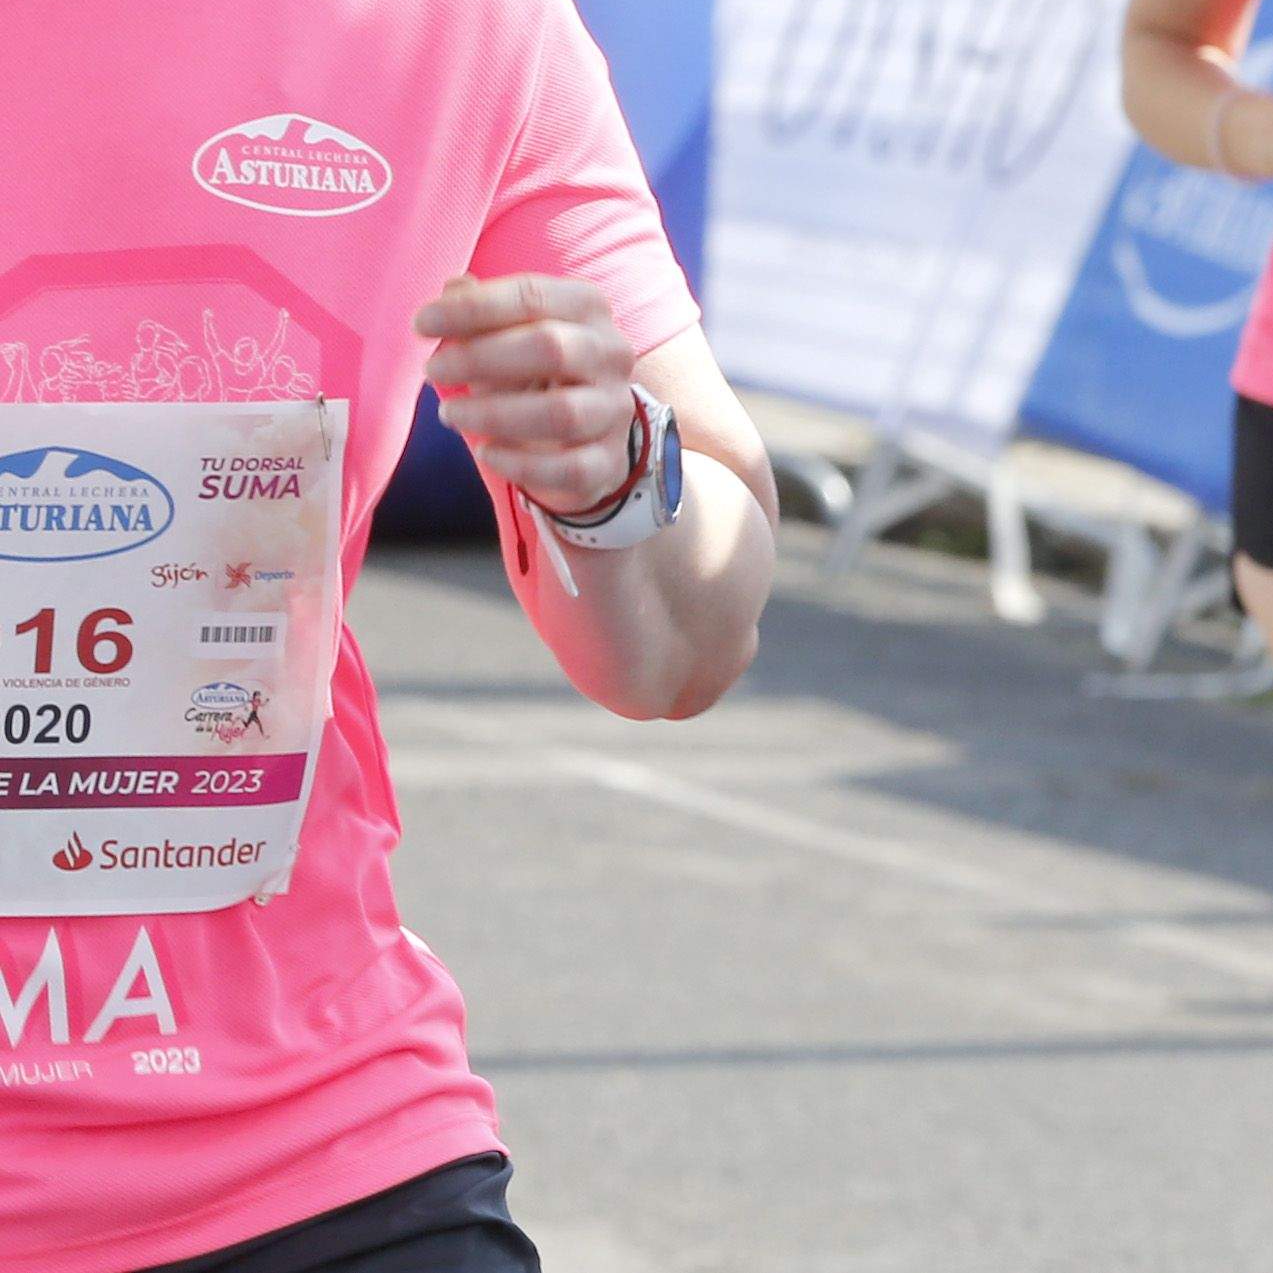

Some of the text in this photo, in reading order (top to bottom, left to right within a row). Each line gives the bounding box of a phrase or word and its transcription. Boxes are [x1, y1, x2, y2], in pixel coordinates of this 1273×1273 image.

[242, 145, 369, 166] CENTRAL LECHERA
[209, 147, 377, 194] ASTURIANA
[200, 456, 305, 472] TU DORSAL
[69, 486, 149, 498] LECHERA
[198, 474, 302, 501] SUMA
[3, 677, 63, 689] VIOLENCIA
[65, 677, 80, 688] DE
[4, 703, 92, 745] 020
[19, 772, 59, 797] LA
[68, 770, 180, 796] MUJER
[191, 769, 265, 794] 2023
[99, 837, 267, 870] Santander
[130, 1045, 202, 1076] 2023
